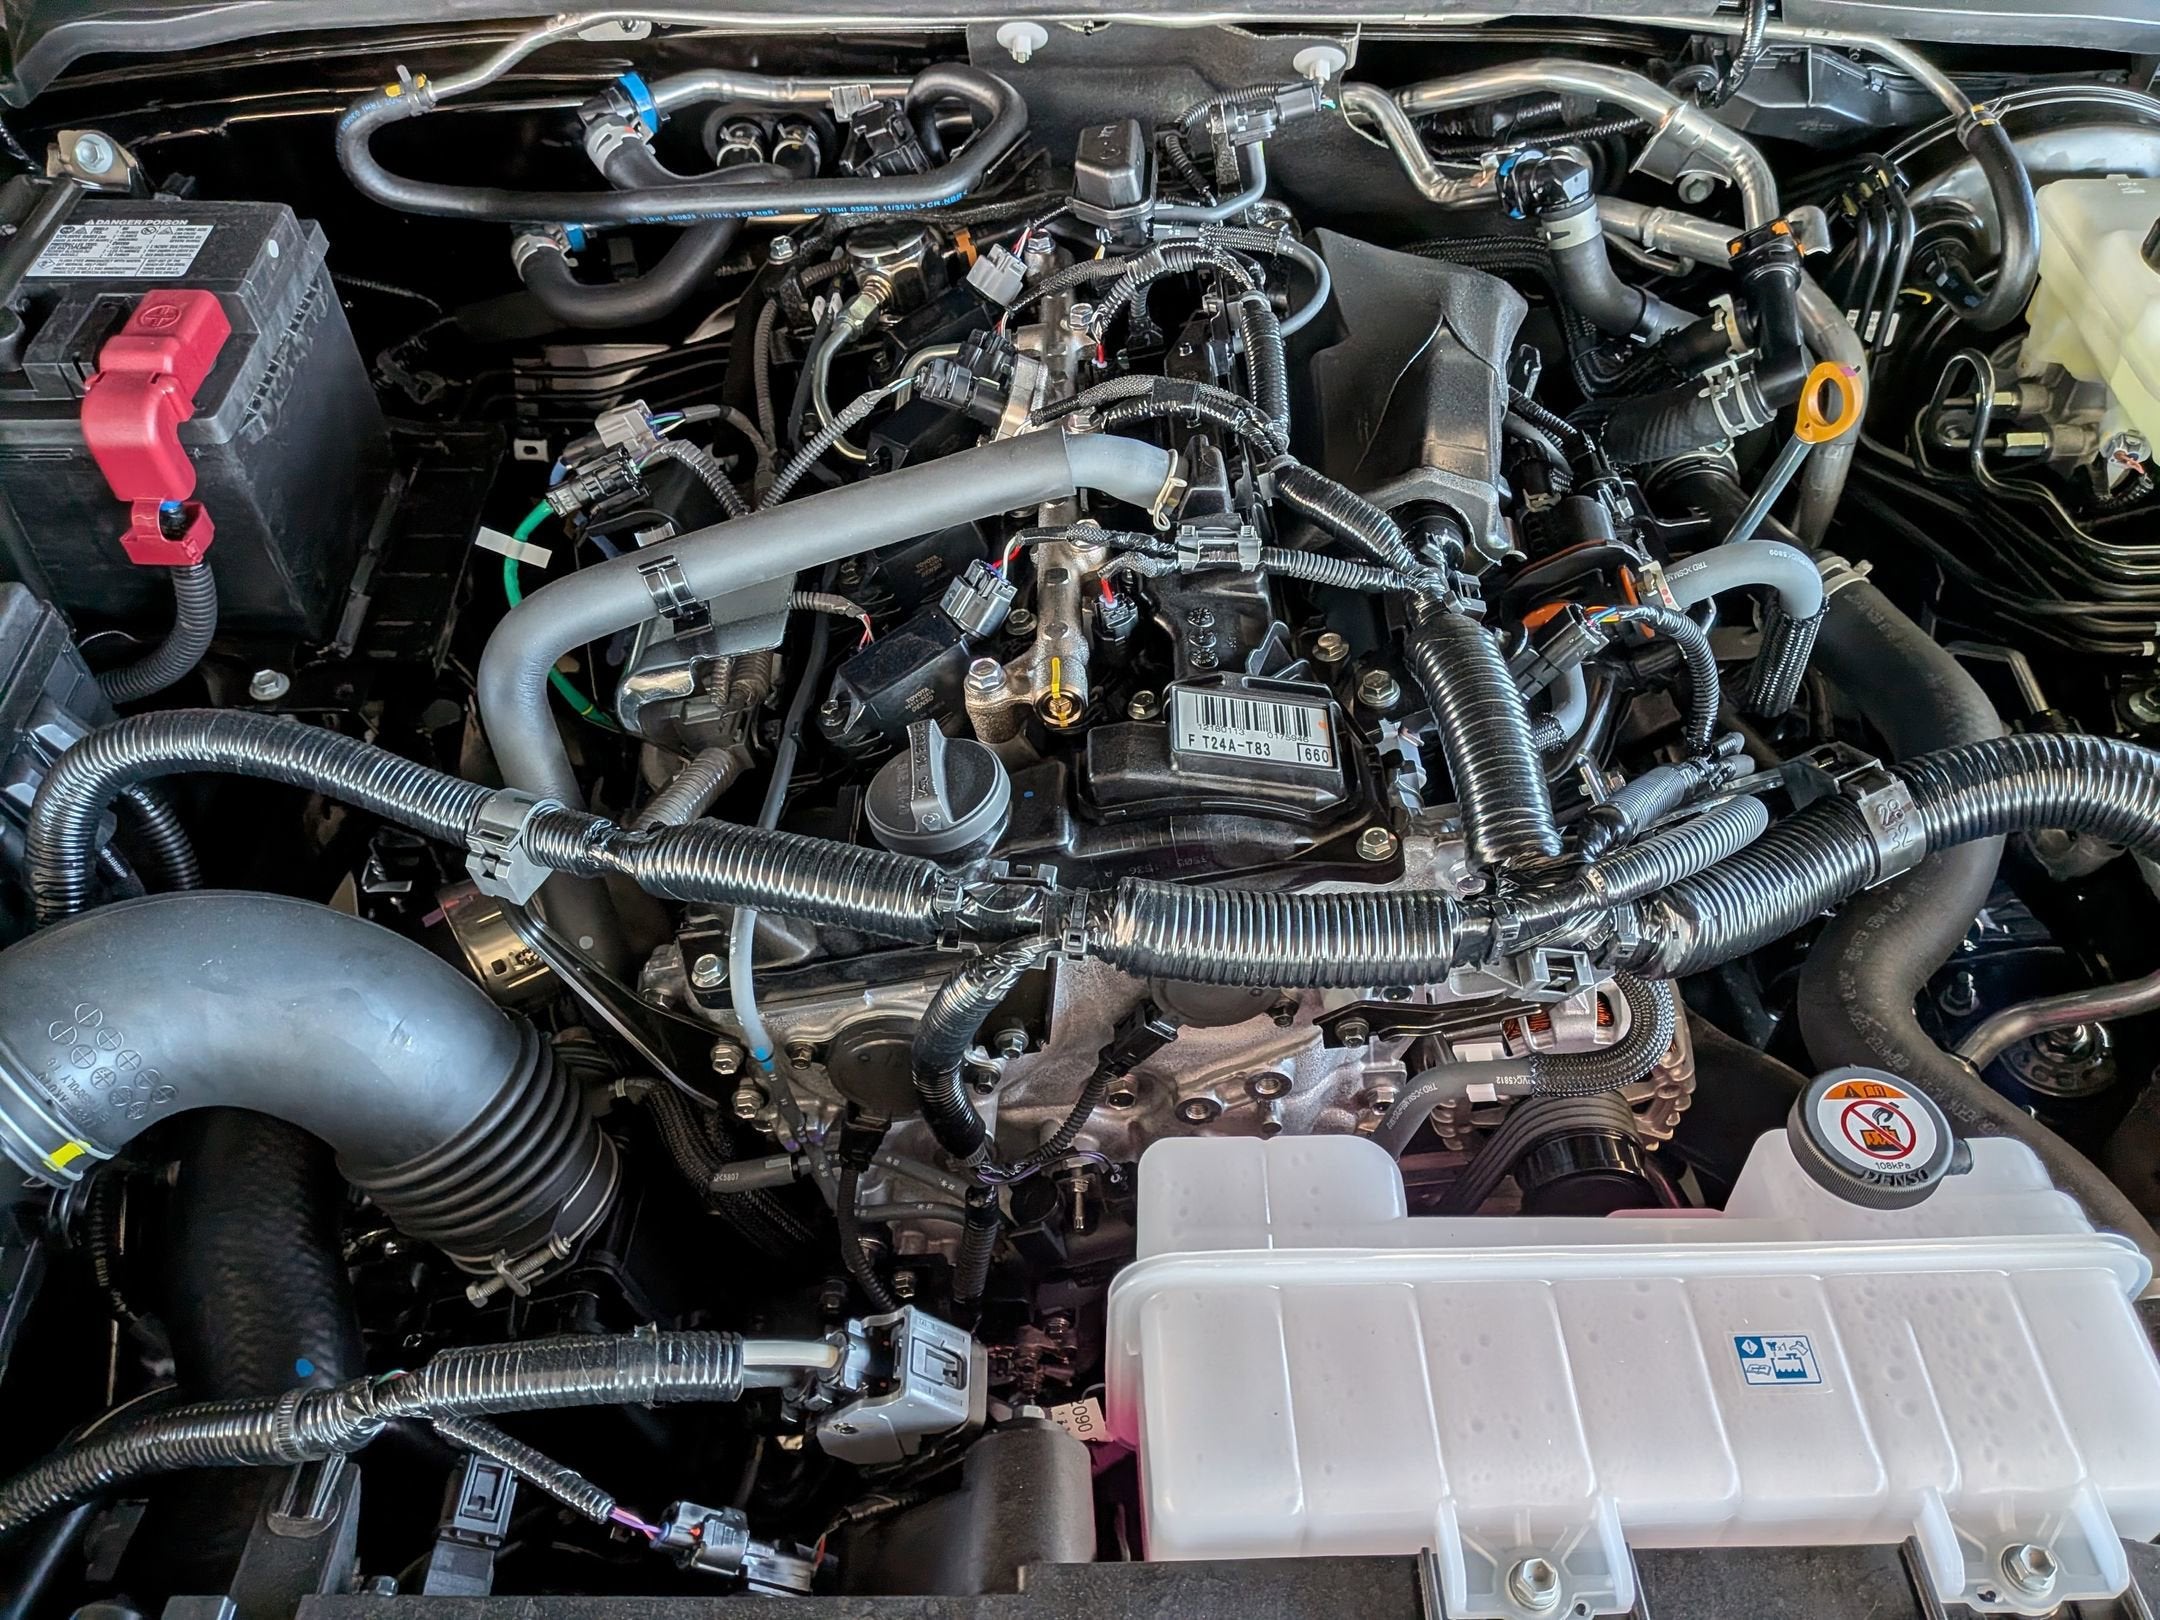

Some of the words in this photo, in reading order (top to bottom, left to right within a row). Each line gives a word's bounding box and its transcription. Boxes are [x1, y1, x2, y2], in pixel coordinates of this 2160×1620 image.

[1202, 735, 1271, 757] T24A-T83
[1305, 747, 1329, 763] 660
[1875, 1161, 1911, 1170] 108kPa
[1861, 1169, 1929, 1187] DENSO
